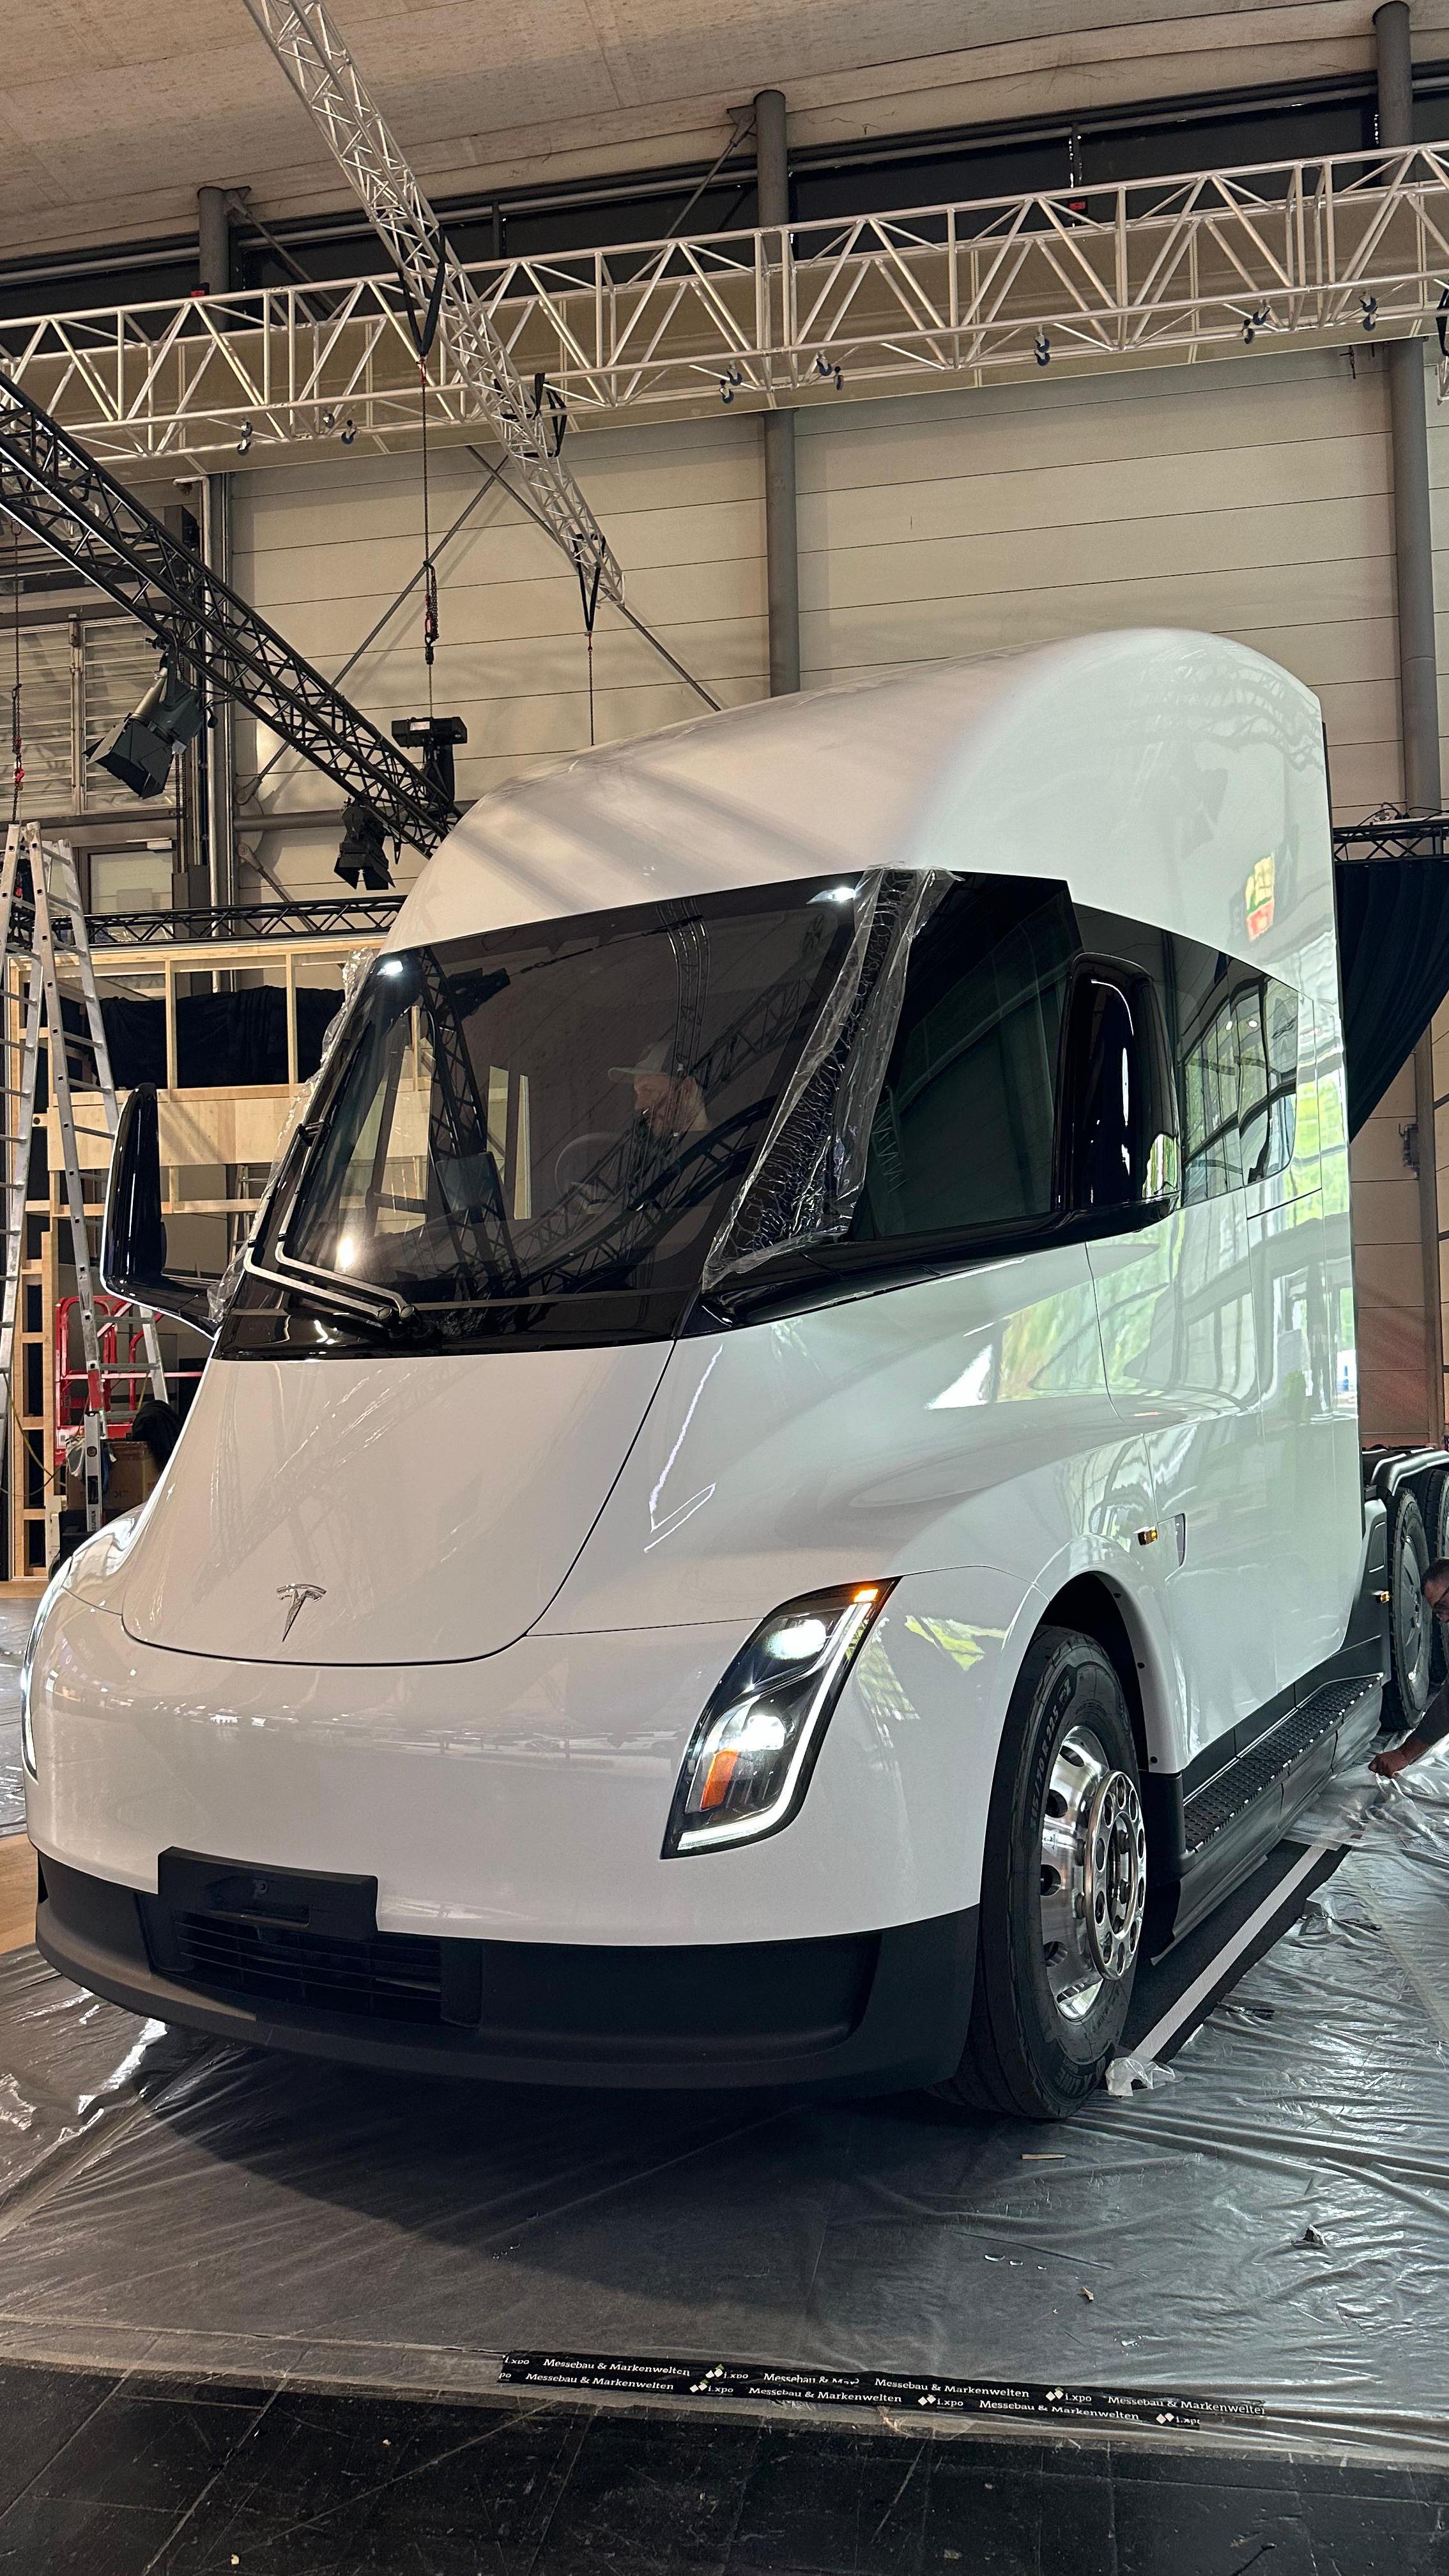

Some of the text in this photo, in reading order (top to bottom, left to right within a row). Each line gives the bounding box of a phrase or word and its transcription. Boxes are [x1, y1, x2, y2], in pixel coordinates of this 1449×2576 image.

[525, 2373, 577, 2383] Messebau
[592, 2377, 674, 2389] Markenwelten
[708, 2385, 733, 2394] i.xpo
[748, 2388, 801, 2397] Messebau
[817, 2391, 902, 2402] Markenwelten
[937, 2398, 964, 2407] i.xpo
[979, 2400, 1035, 2411] Messebau
[1052, 2406, 1140, 2420] Markenwelten
[543, 2358, 594, 2369] Messebau
[609, 2363, 690, 2377] Markenwelten
[875, 2378, 928, 2391] Messebau
[944, 2385, 1029, 2398] Markenwelten
[1065, 2393, 1092, 2402] i.xpo
[1108, 2396, 1163, 2407] Messebau
